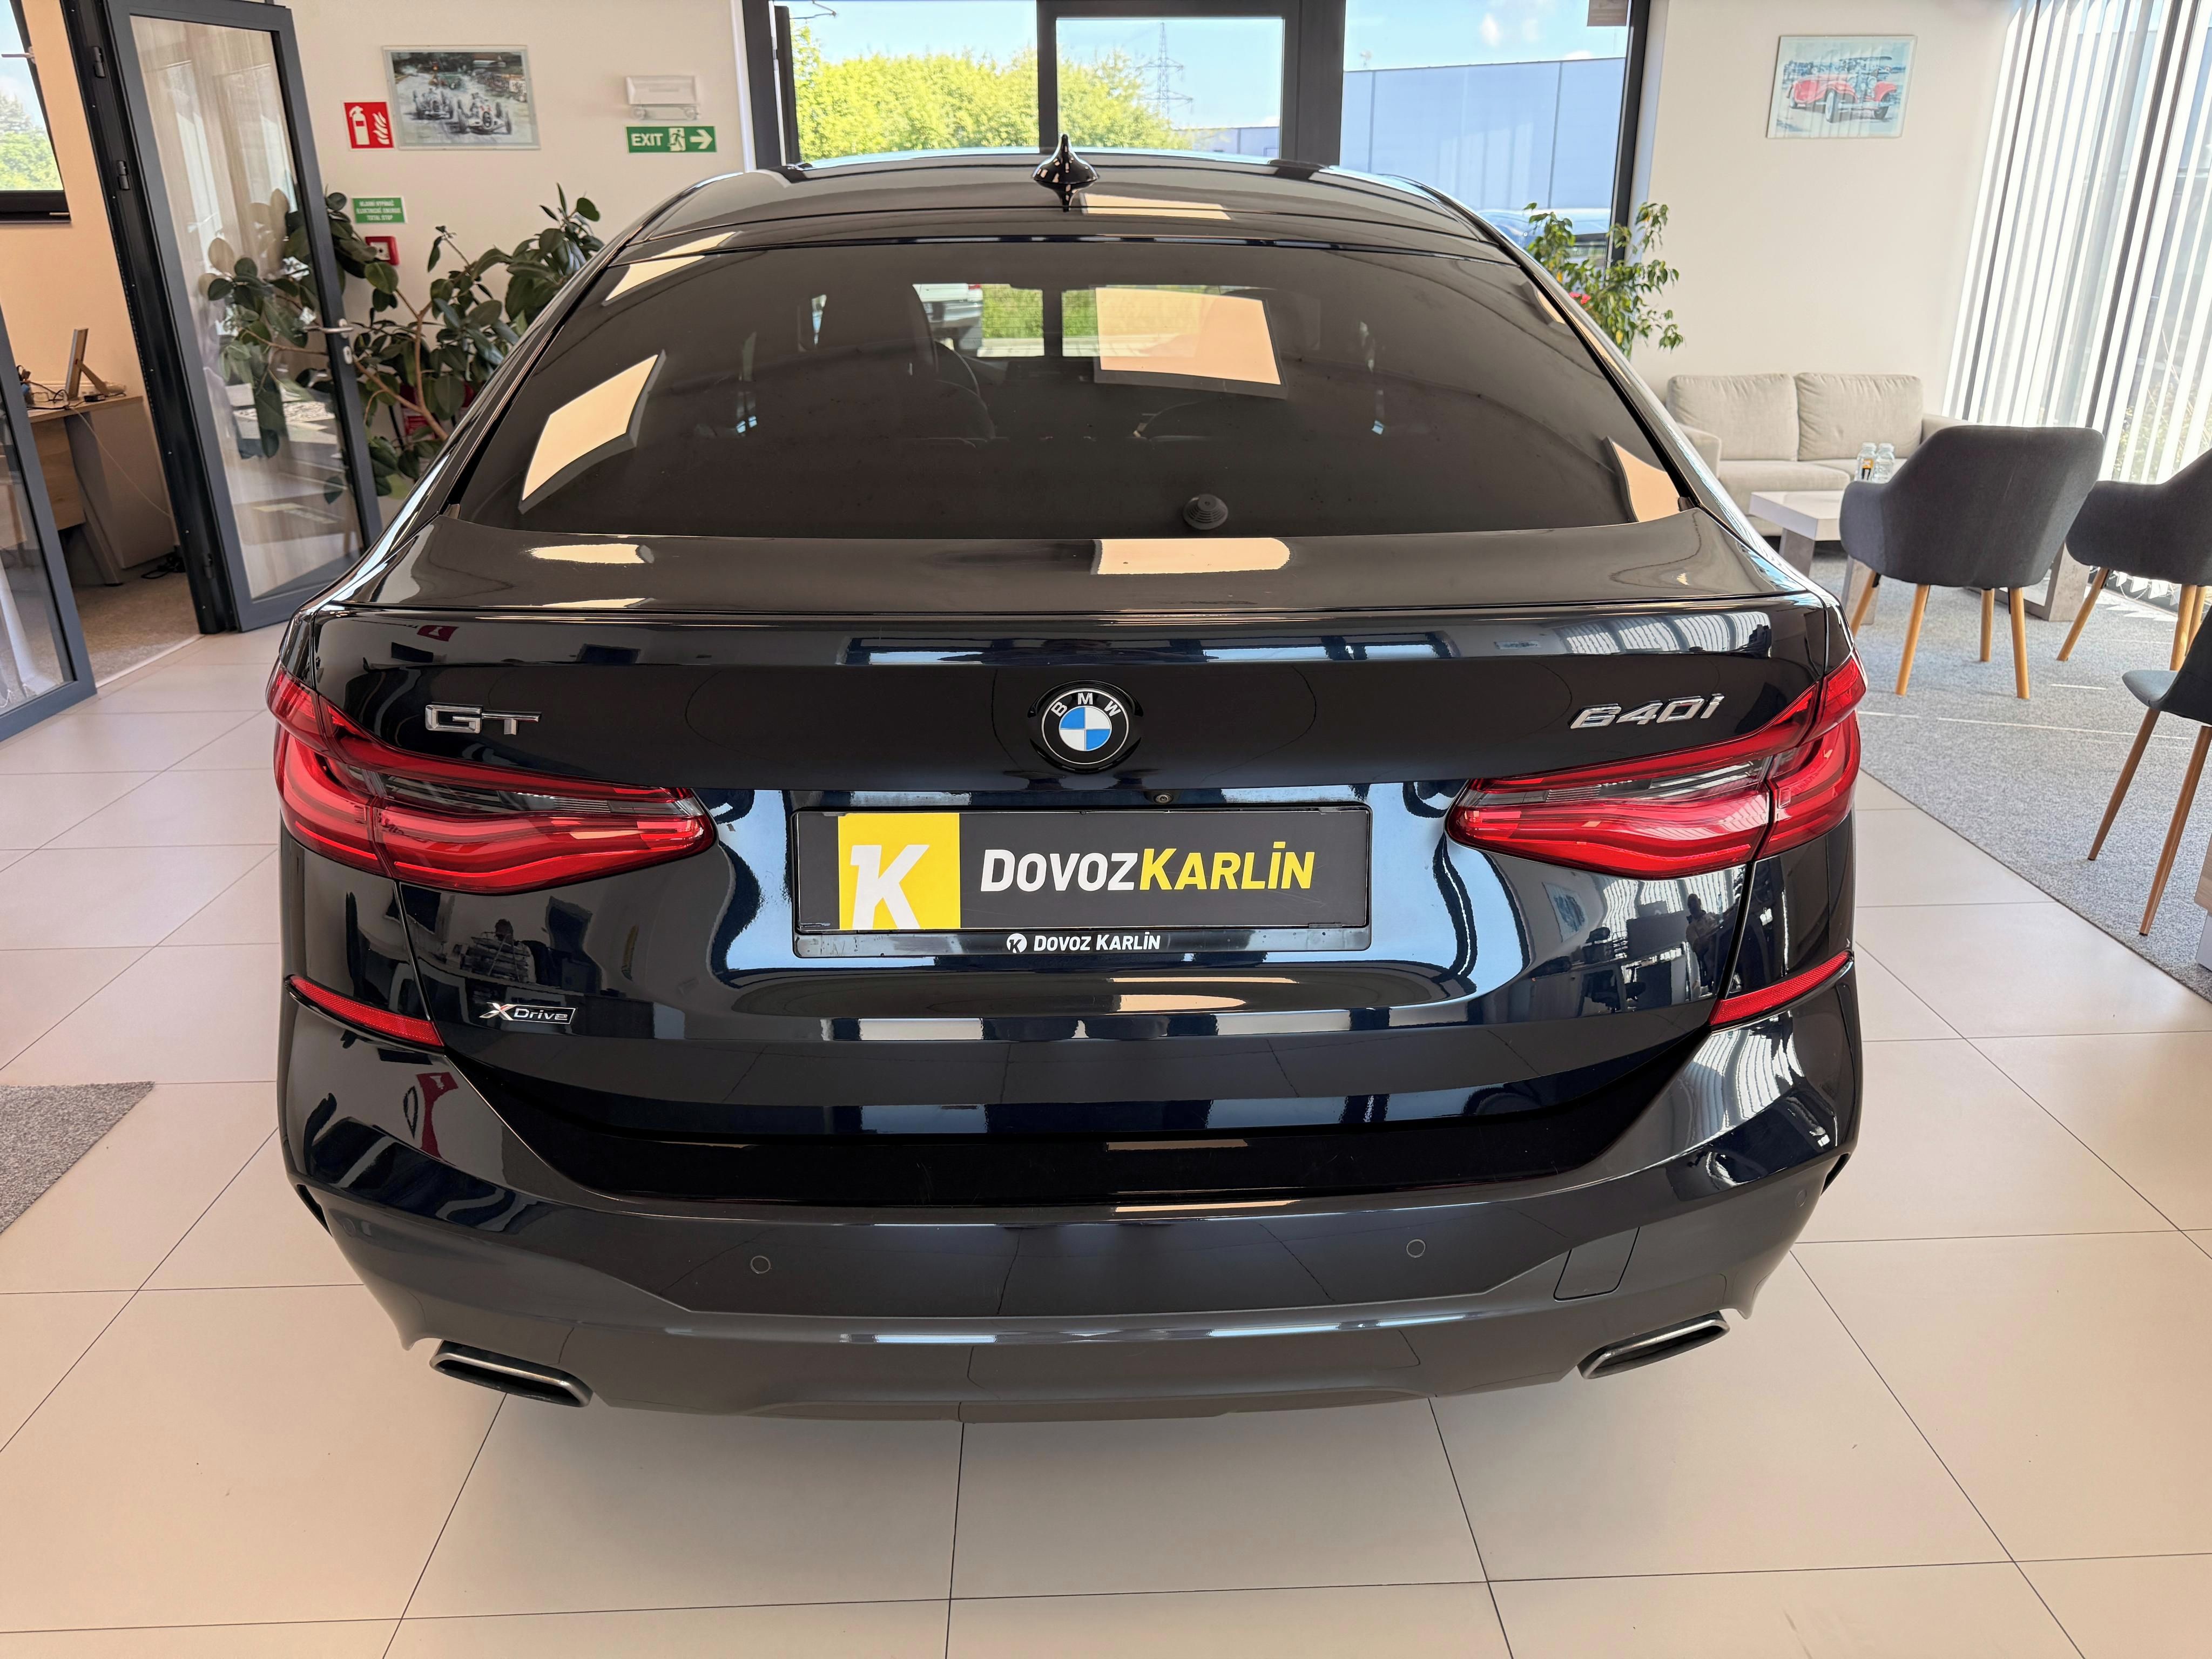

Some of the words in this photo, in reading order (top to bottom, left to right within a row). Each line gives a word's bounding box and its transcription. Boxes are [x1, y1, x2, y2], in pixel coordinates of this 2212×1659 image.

[631, 133, 664, 146] EXIT
[1051, 692, 1121, 717] BMW
[1569, 693, 1725, 729] 640i
[425, 703, 540, 735] GT
[1034, 935, 1091, 952] DOVOZ
